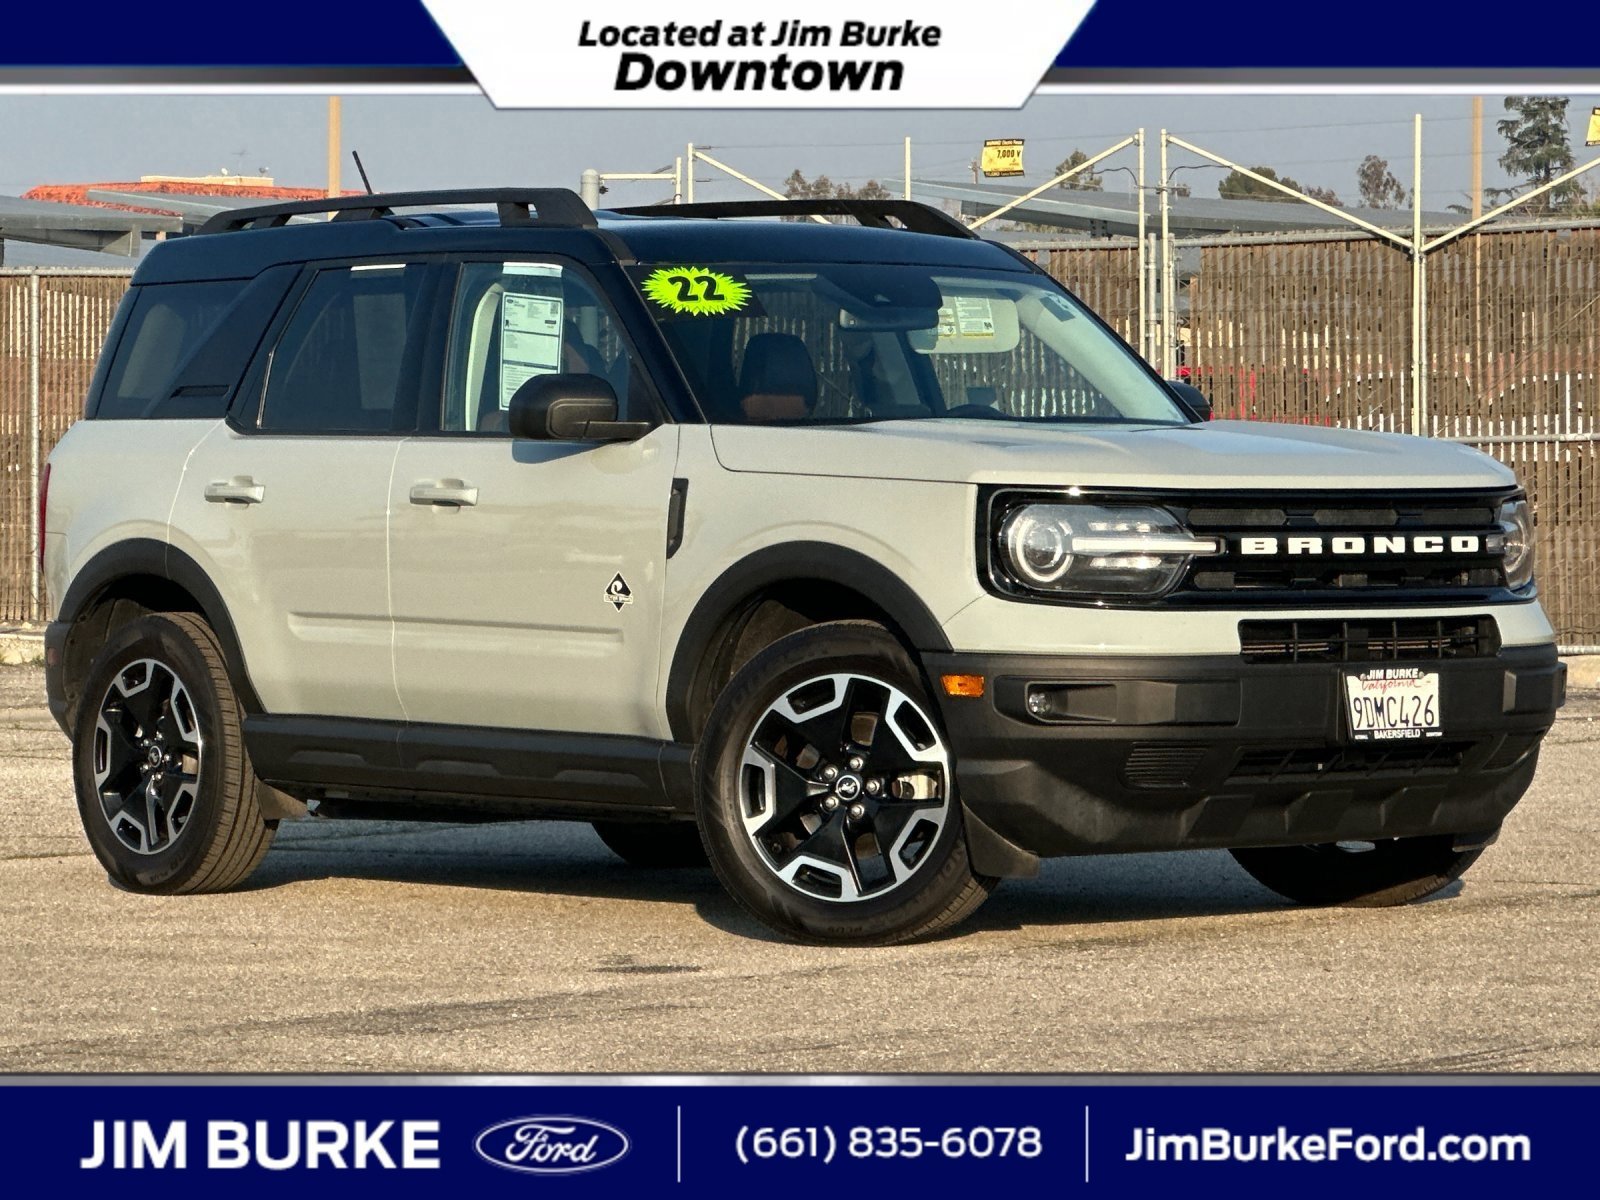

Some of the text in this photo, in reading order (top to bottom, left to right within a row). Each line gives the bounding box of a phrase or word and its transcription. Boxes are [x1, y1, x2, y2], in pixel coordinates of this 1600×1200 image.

[667, 275, 725, 302] 22
[1240, 535, 1479, 555] BRONCO
[1366, 668, 1419, 680] JIM BURKE
[1353, 694, 1435, 729] 9DMC426
[1373, 729, 1421, 740] BAKERSFIELD
